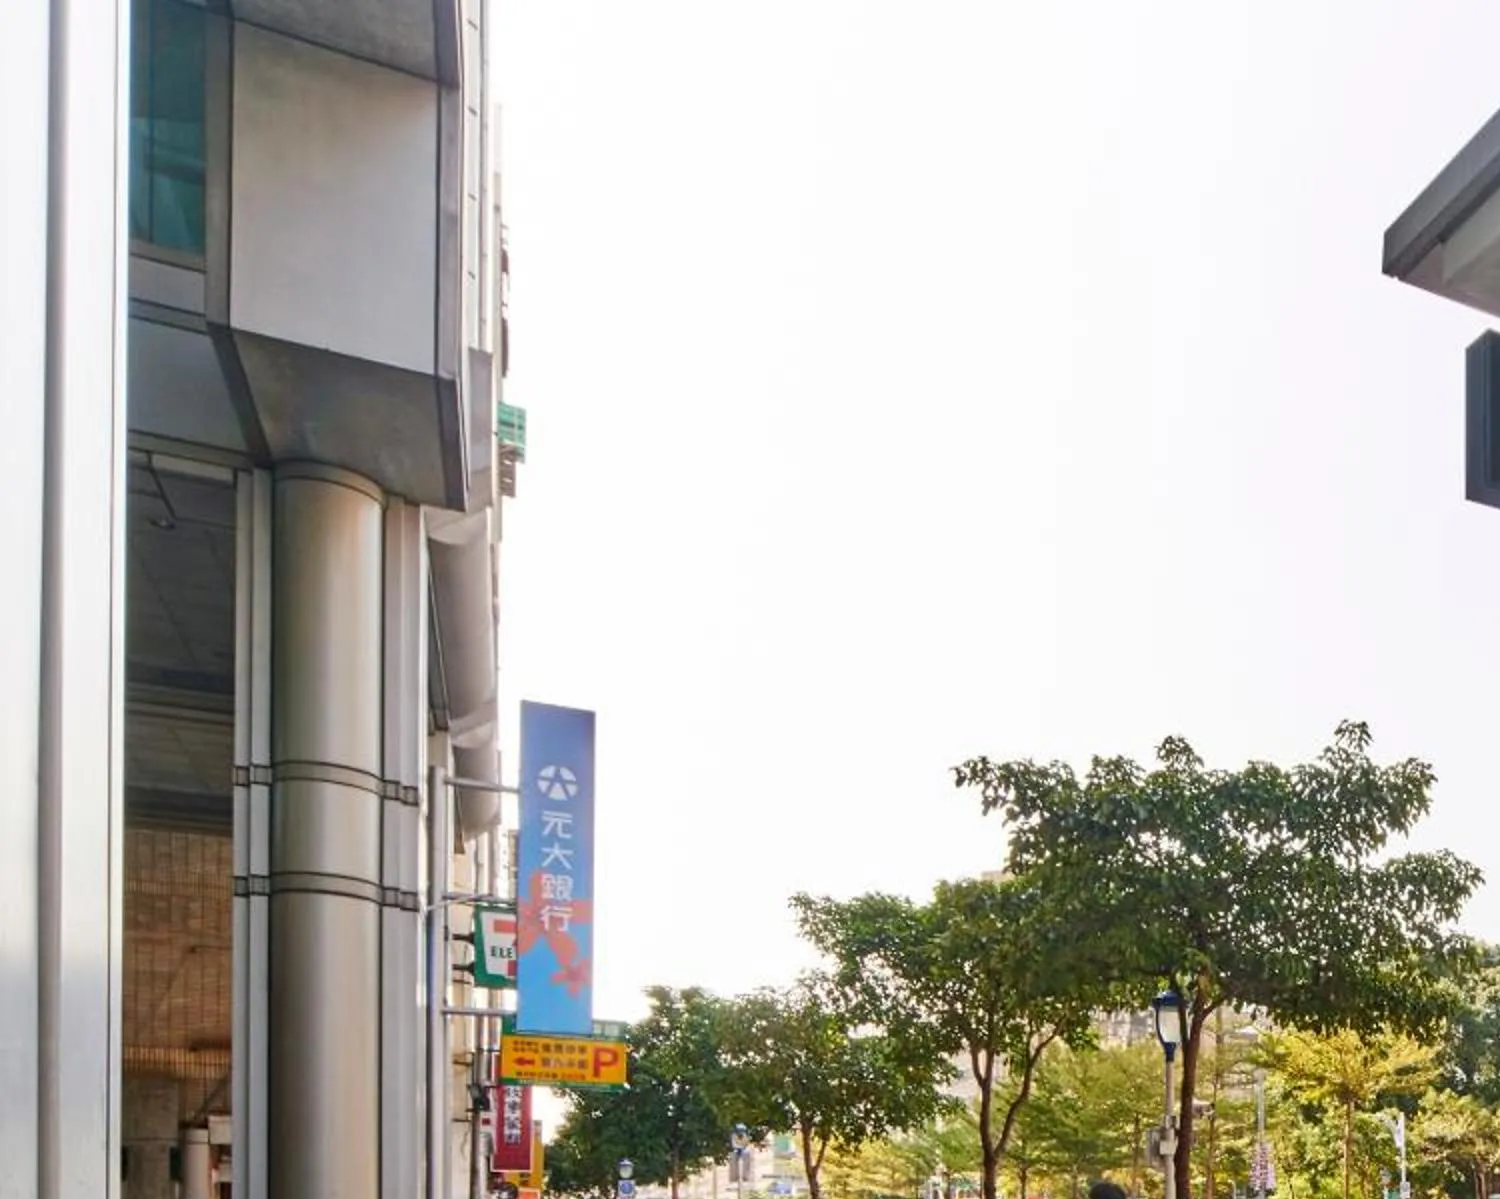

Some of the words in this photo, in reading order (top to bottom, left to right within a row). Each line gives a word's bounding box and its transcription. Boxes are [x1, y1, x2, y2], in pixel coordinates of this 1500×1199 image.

[540, 810, 574, 932] 元大銀行
[592, 1046, 619, 1079] P
